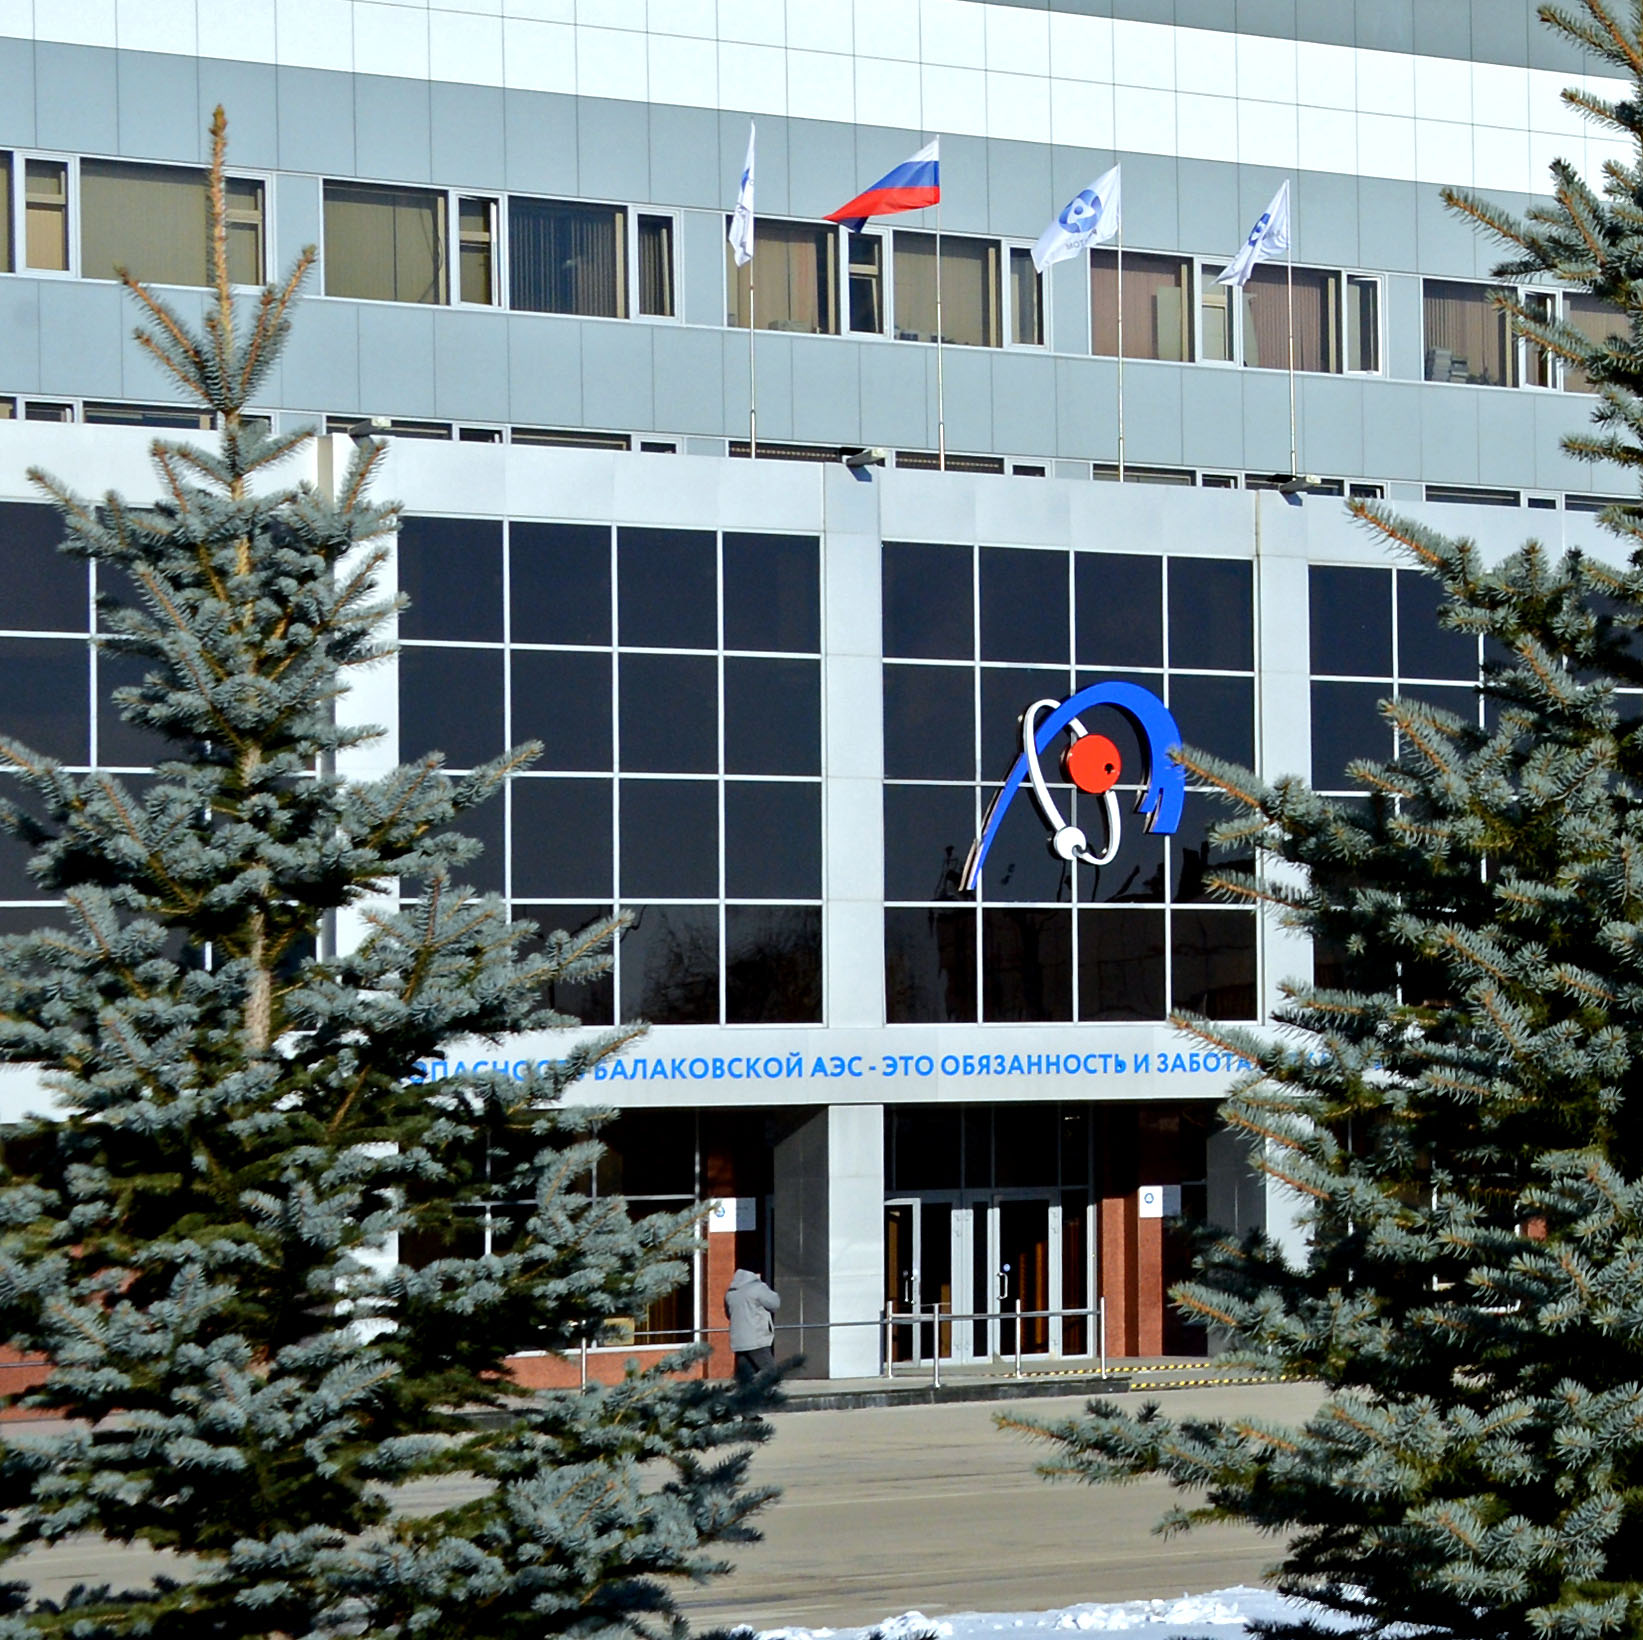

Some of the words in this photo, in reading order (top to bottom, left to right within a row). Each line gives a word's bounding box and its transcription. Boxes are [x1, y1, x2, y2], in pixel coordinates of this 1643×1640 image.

[594, 1052, 803, 1081] БАЛАКОВСКОЙ
[811, 1055, 863, 1078] АЭС
[881, 1055, 934, 1077] ЭТО
[940, 1053, 1127, 1076] ОБЯЗАННОСТЬ
[1133, 1053, 1150, 1073] И
[1156, 1052, 1251, 1073] ЗАБОТА
